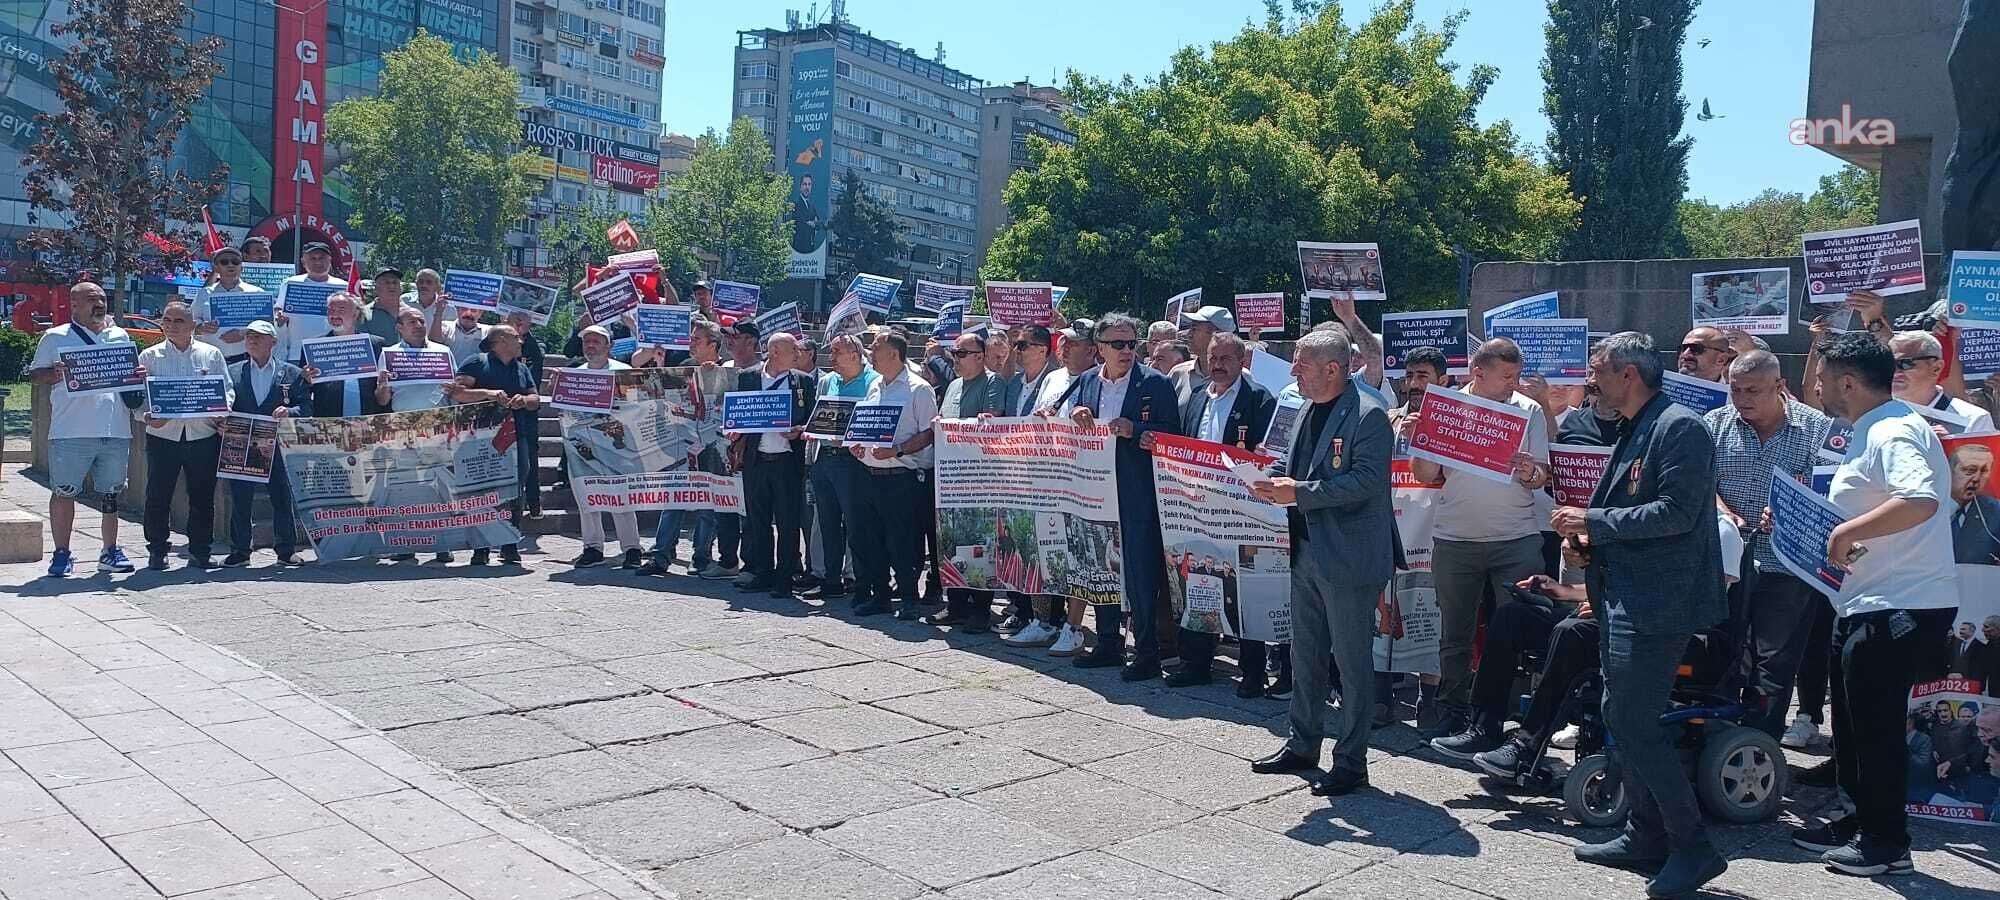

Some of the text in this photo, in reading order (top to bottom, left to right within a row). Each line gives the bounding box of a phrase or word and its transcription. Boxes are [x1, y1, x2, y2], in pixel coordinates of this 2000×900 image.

[292, 40, 318, 184] GAMA
[527, 123, 615, 159] ROSE'S LUCK
[596, 159, 634, 184] tatilino
[1805, 237, 1920, 257] KOMUTANLARIMIZDAN DAHA
[1824, 233, 1898, 248] SİVİL HAYATIMIZLA
[1814, 246, 1912, 264] PARLAK BİR GELECEĞİMİZ
[1809, 271, 1835, 280] ANCAK
[1836, 268, 1858, 279] ŞEHİT
[1870, 264, 1889, 274] GAZİ
[1955, 265, 1985, 276] AYNI
[1402, 328, 1445, 337] VERDİK, EŞİT
[1391, 339, 1436, 347] HAKLARIMIZI
[736, 396, 755, 404] ŞEHİT
[960, 423, 981, 434] ŞEHİT
[1430, 411, 1510, 441] KARŞILIĞI EMSAL
[1034, 436, 1054, 446] EVLAT
[1021, 447, 1039, 457] DAHA
[1039, 448, 1049, 457] AZ
[1167, 443, 1194, 461] RESİM
[1215, 475, 1225, 484] VE
[1553, 467, 1576, 479] AYNI,
[1559, 479, 1589, 488] NEDEN
[587, 490, 710, 507] SOSYAL HAKLAR NEDEN
[499, 510, 513, 519] de
[1223, 521, 1244, 529] geride
[1918, 679, 1970, 696] 09.02.2024
[1904, 803, 1974, 819] 25.03.2024
